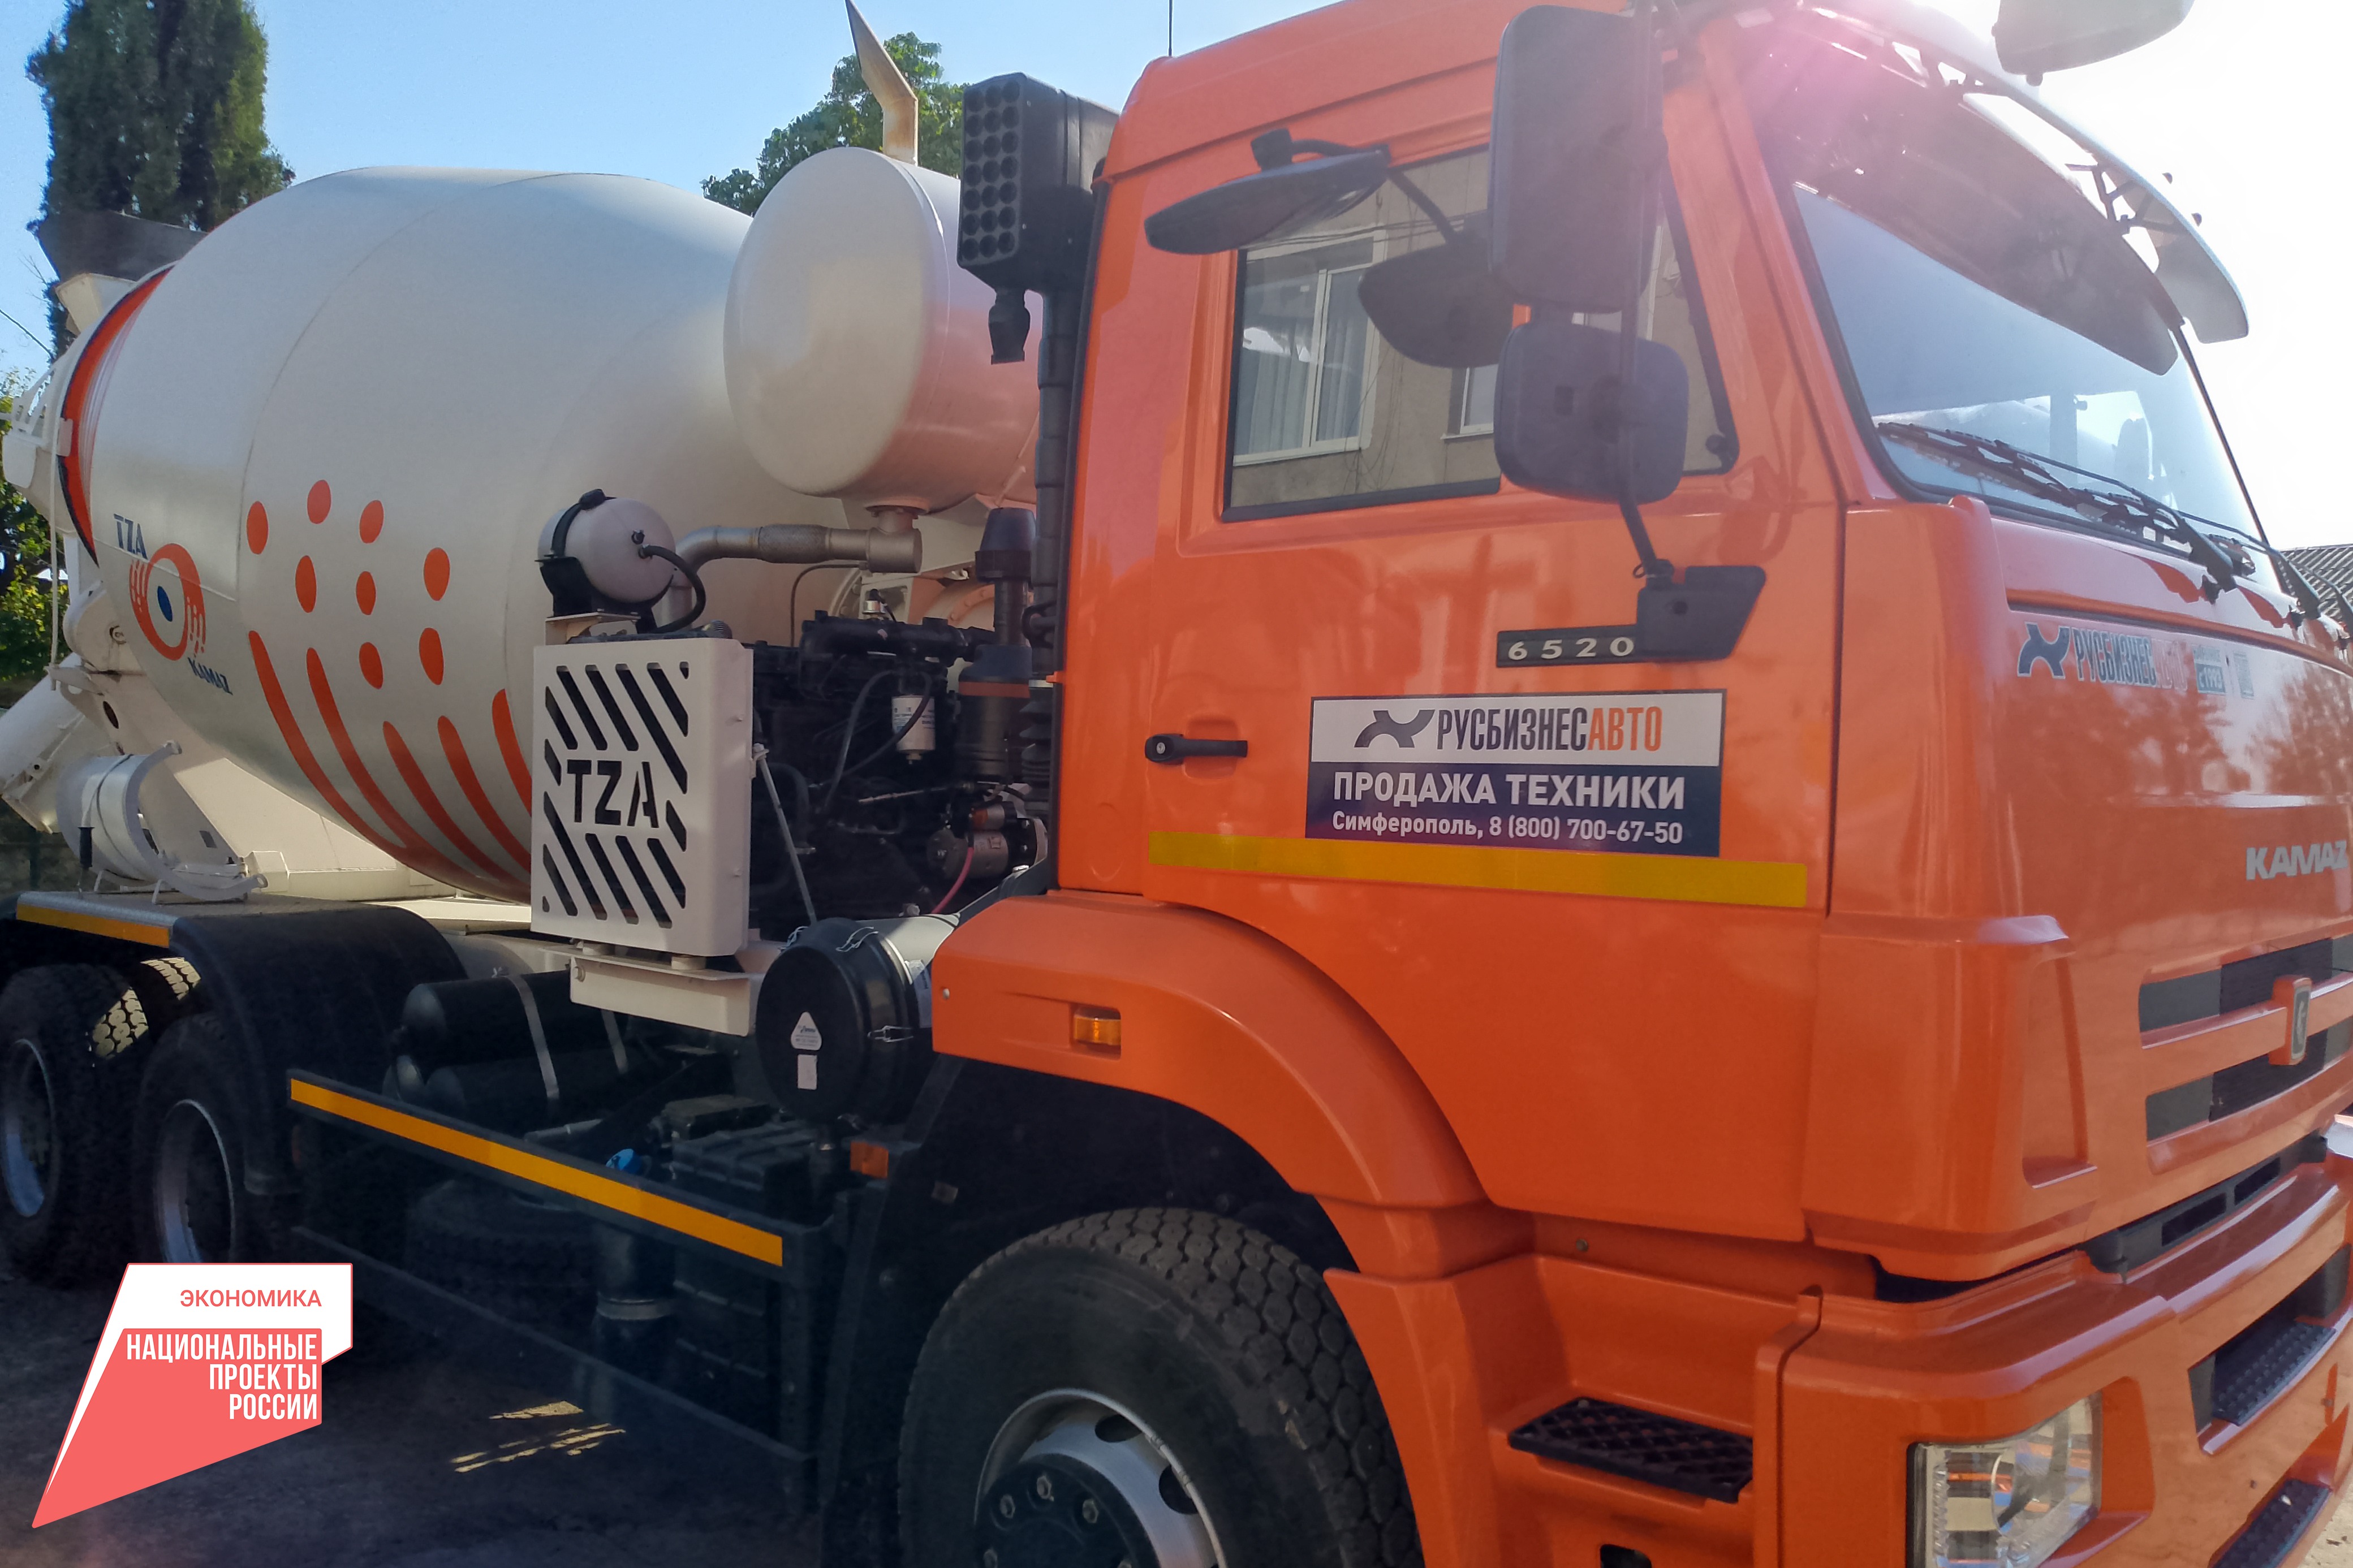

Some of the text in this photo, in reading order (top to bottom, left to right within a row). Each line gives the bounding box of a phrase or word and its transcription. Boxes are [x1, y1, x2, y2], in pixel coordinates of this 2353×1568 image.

[114, 513, 148, 560] TZA
[1508, 637, 1635, 660] 6520
[1436, 706, 1663, 752] РУСБИЗНЕСАВТО
[567, 759, 660, 828] TZA
[1334, 771, 1685, 810] ПРОДАЖА ТЕХНИКИ
[1332, 810, 1683, 844] Симферополь, 8 (800) 700-67-50
[2246, 840, 2349, 881] KAMAZ
